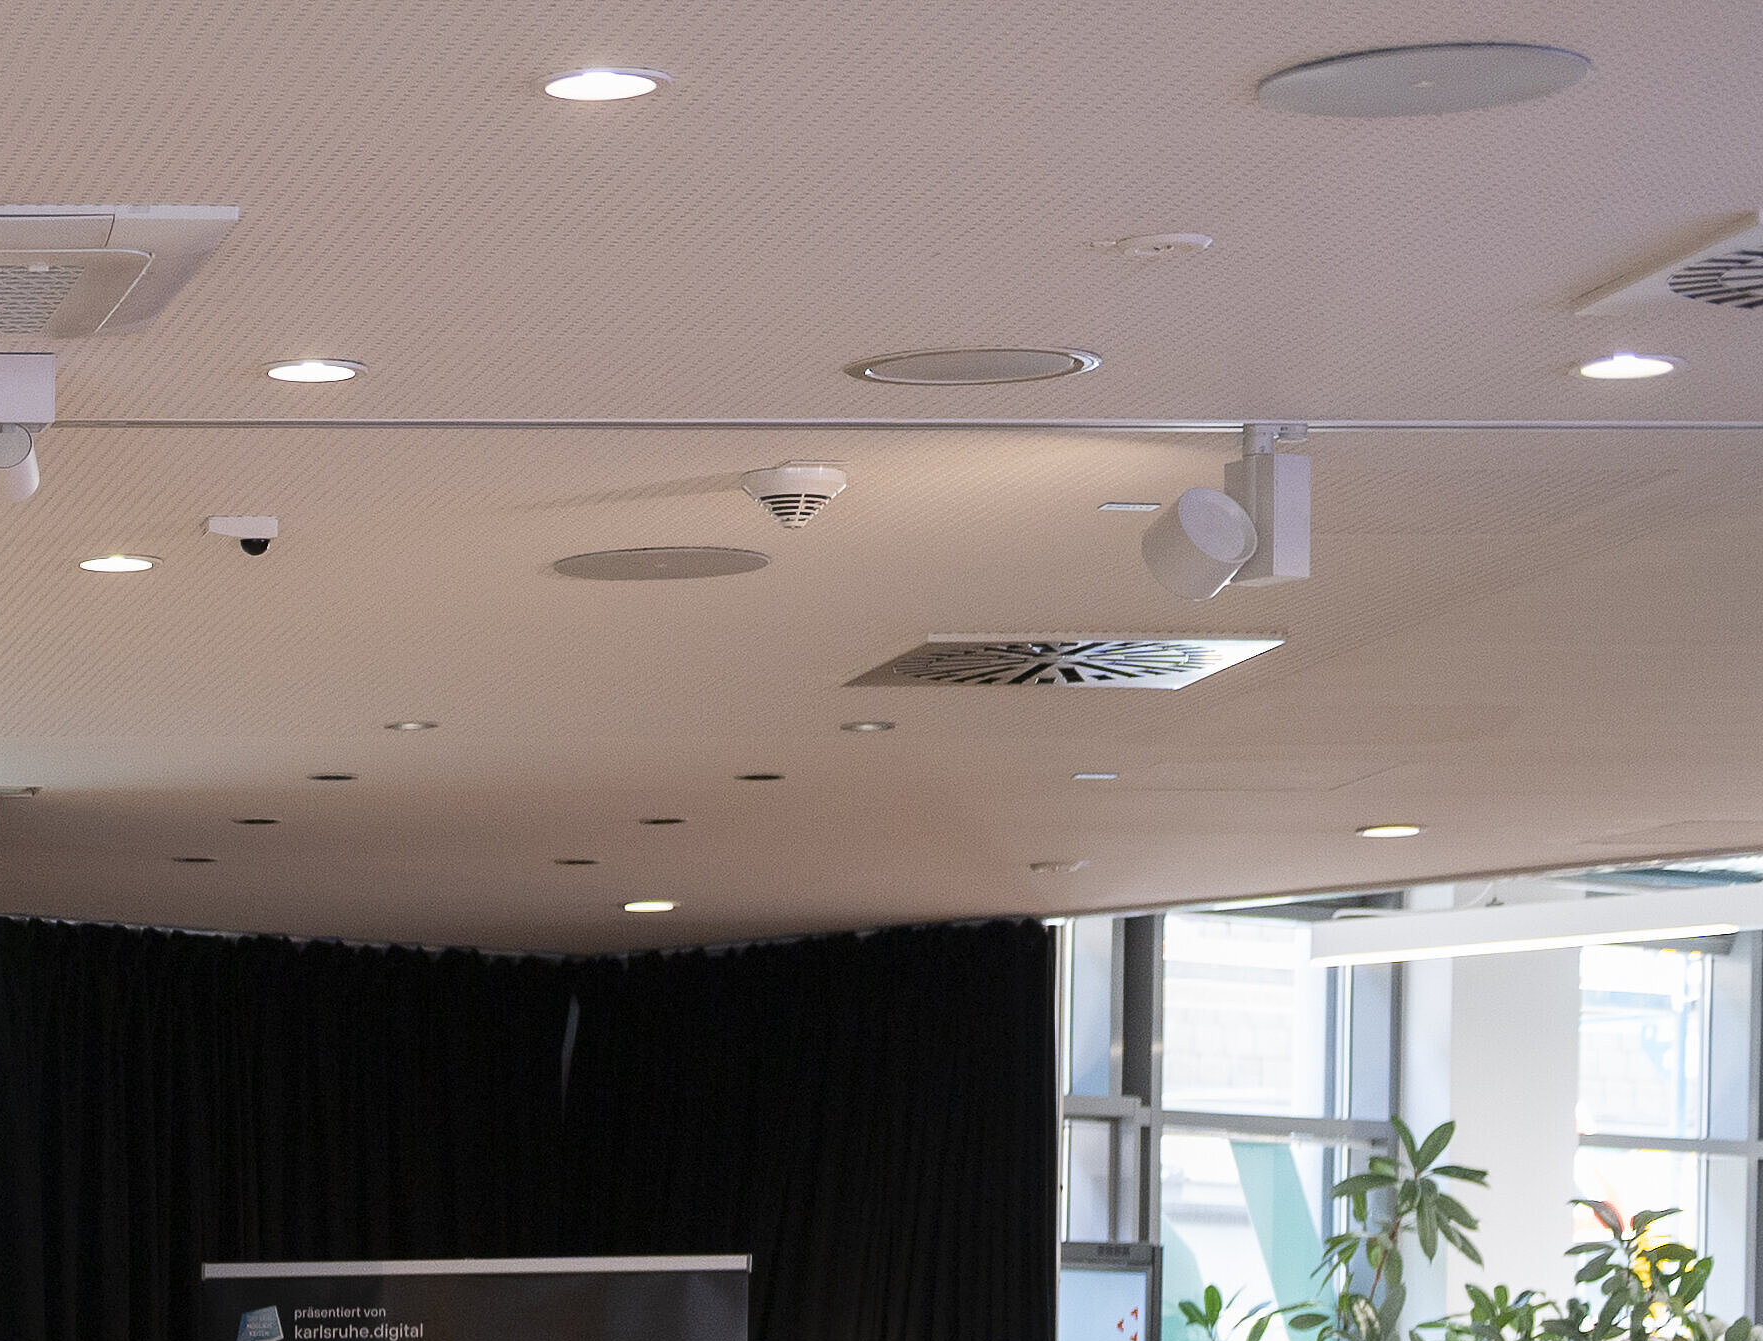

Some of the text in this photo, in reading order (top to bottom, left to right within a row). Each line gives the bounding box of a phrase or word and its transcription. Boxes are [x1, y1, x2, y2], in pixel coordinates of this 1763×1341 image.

[294, 1307, 387, 1320] präsentiert von
[294, 1323, 424, 1341] karlsruhe.digital
